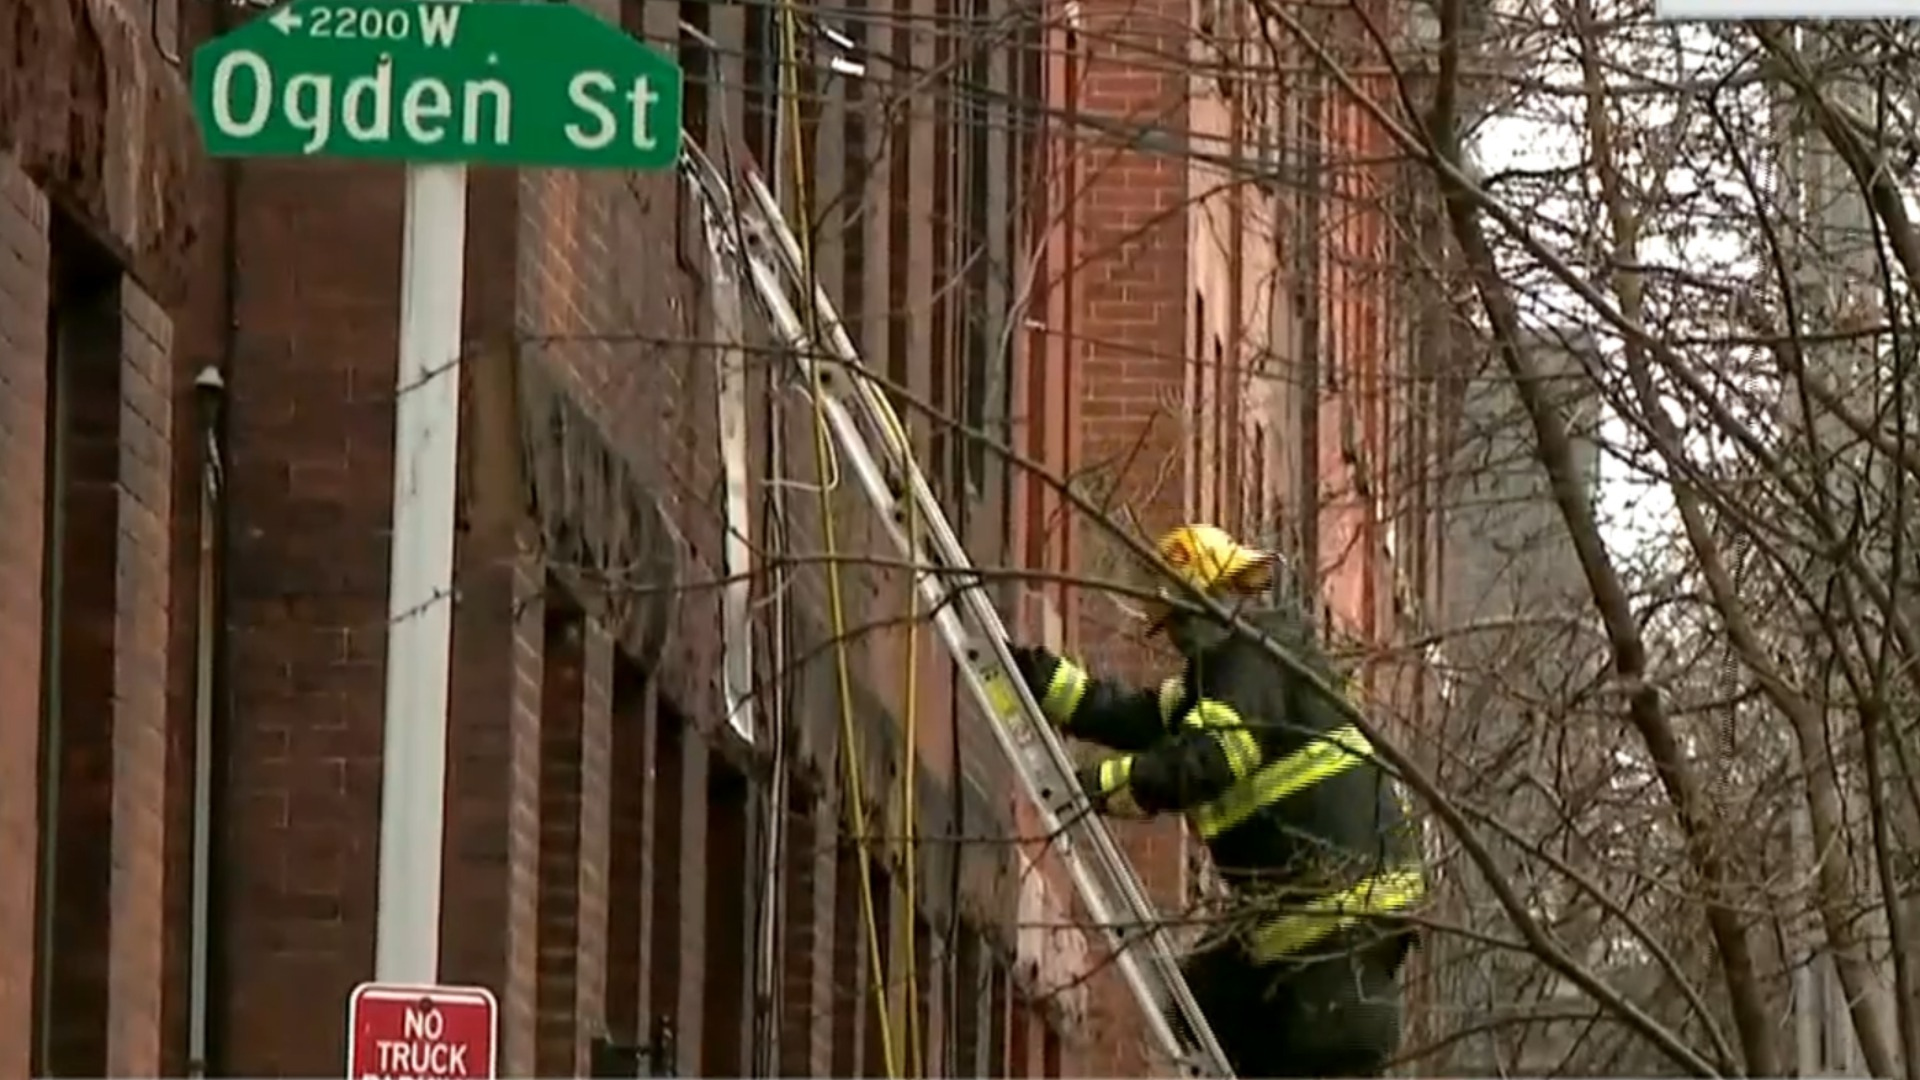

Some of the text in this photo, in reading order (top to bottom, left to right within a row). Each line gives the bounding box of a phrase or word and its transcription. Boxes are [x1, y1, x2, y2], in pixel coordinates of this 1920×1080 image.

[309, 3, 461, 48] 2200 W
[212, 49, 659, 154] Ogden St
[404, 1006, 443, 1040] NO
[376, 1040, 467, 1075] TRUCK
